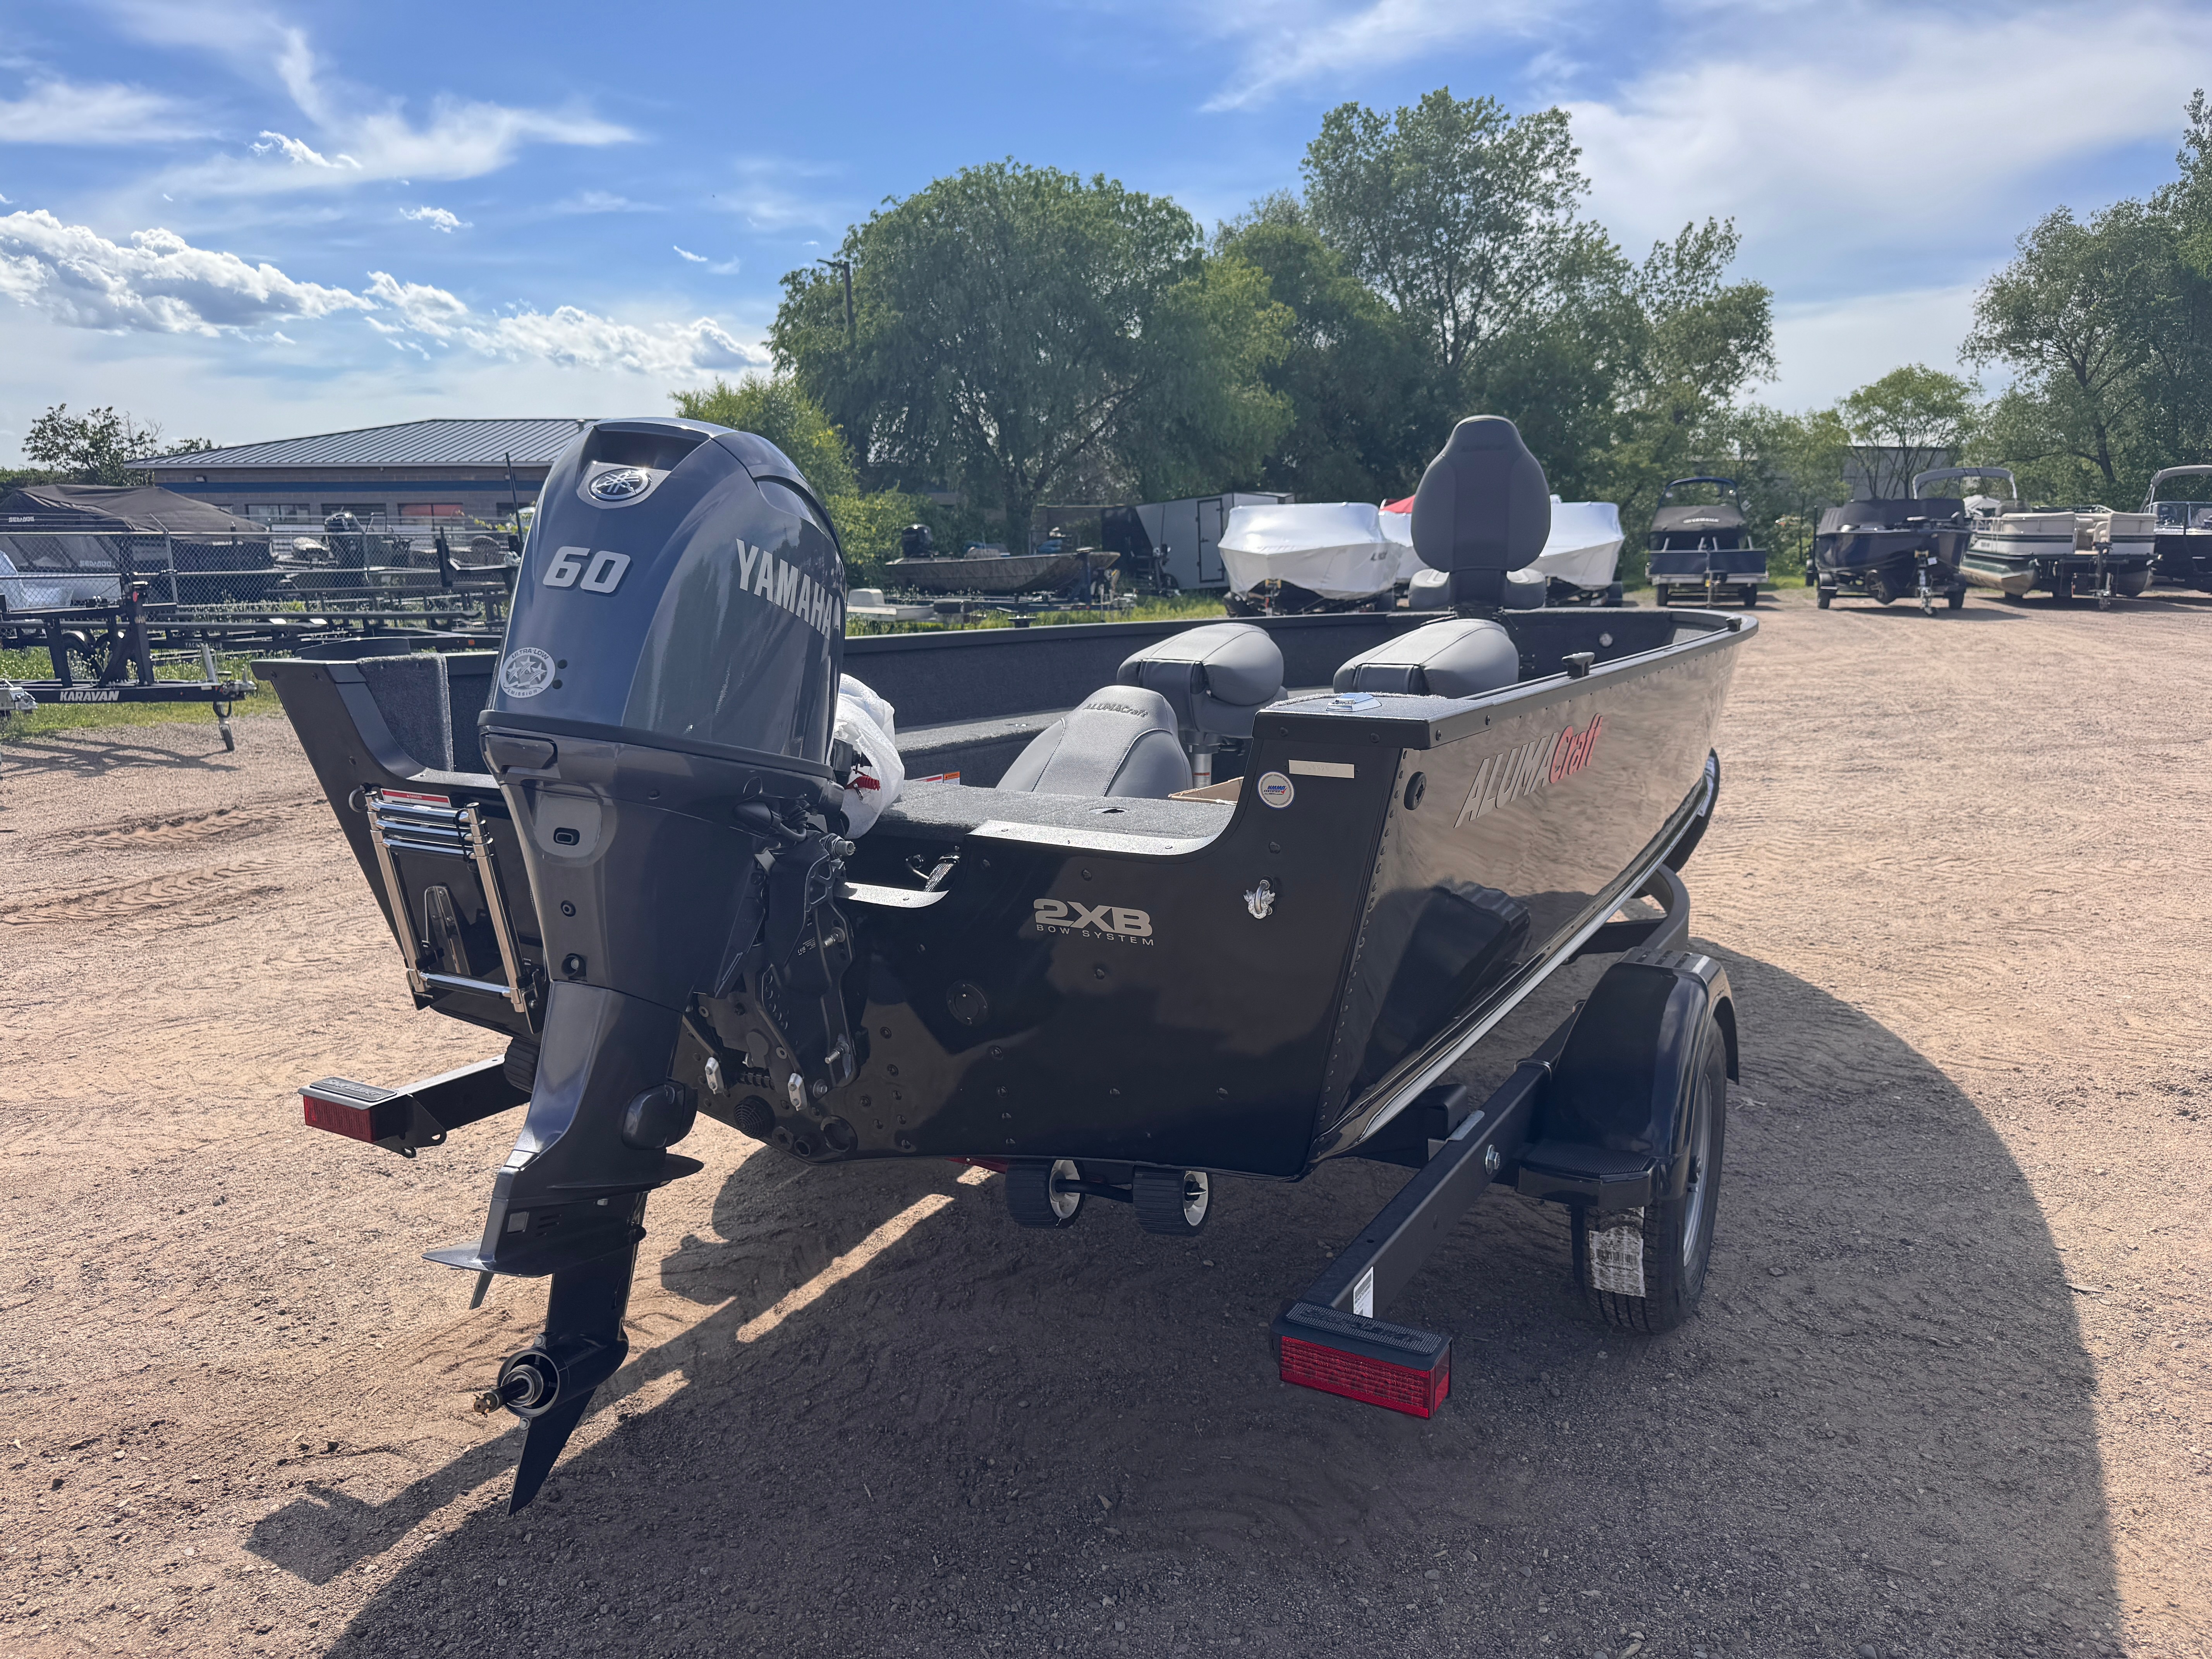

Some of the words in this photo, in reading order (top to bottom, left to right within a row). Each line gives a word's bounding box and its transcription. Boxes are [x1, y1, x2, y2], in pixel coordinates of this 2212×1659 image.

[543, 546, 631, 593] 60
[737, 538, 833, 641] YAMAHA
[60, 690, 120, 701] KARAVAN
[1453, 713, 1603, 829] ALUMACraft
[1033, 898, 1153, 937] 2XB
[1036, 924, 1070, 934] BOW
[1082, 930, 1154, 946] SYSTEM
